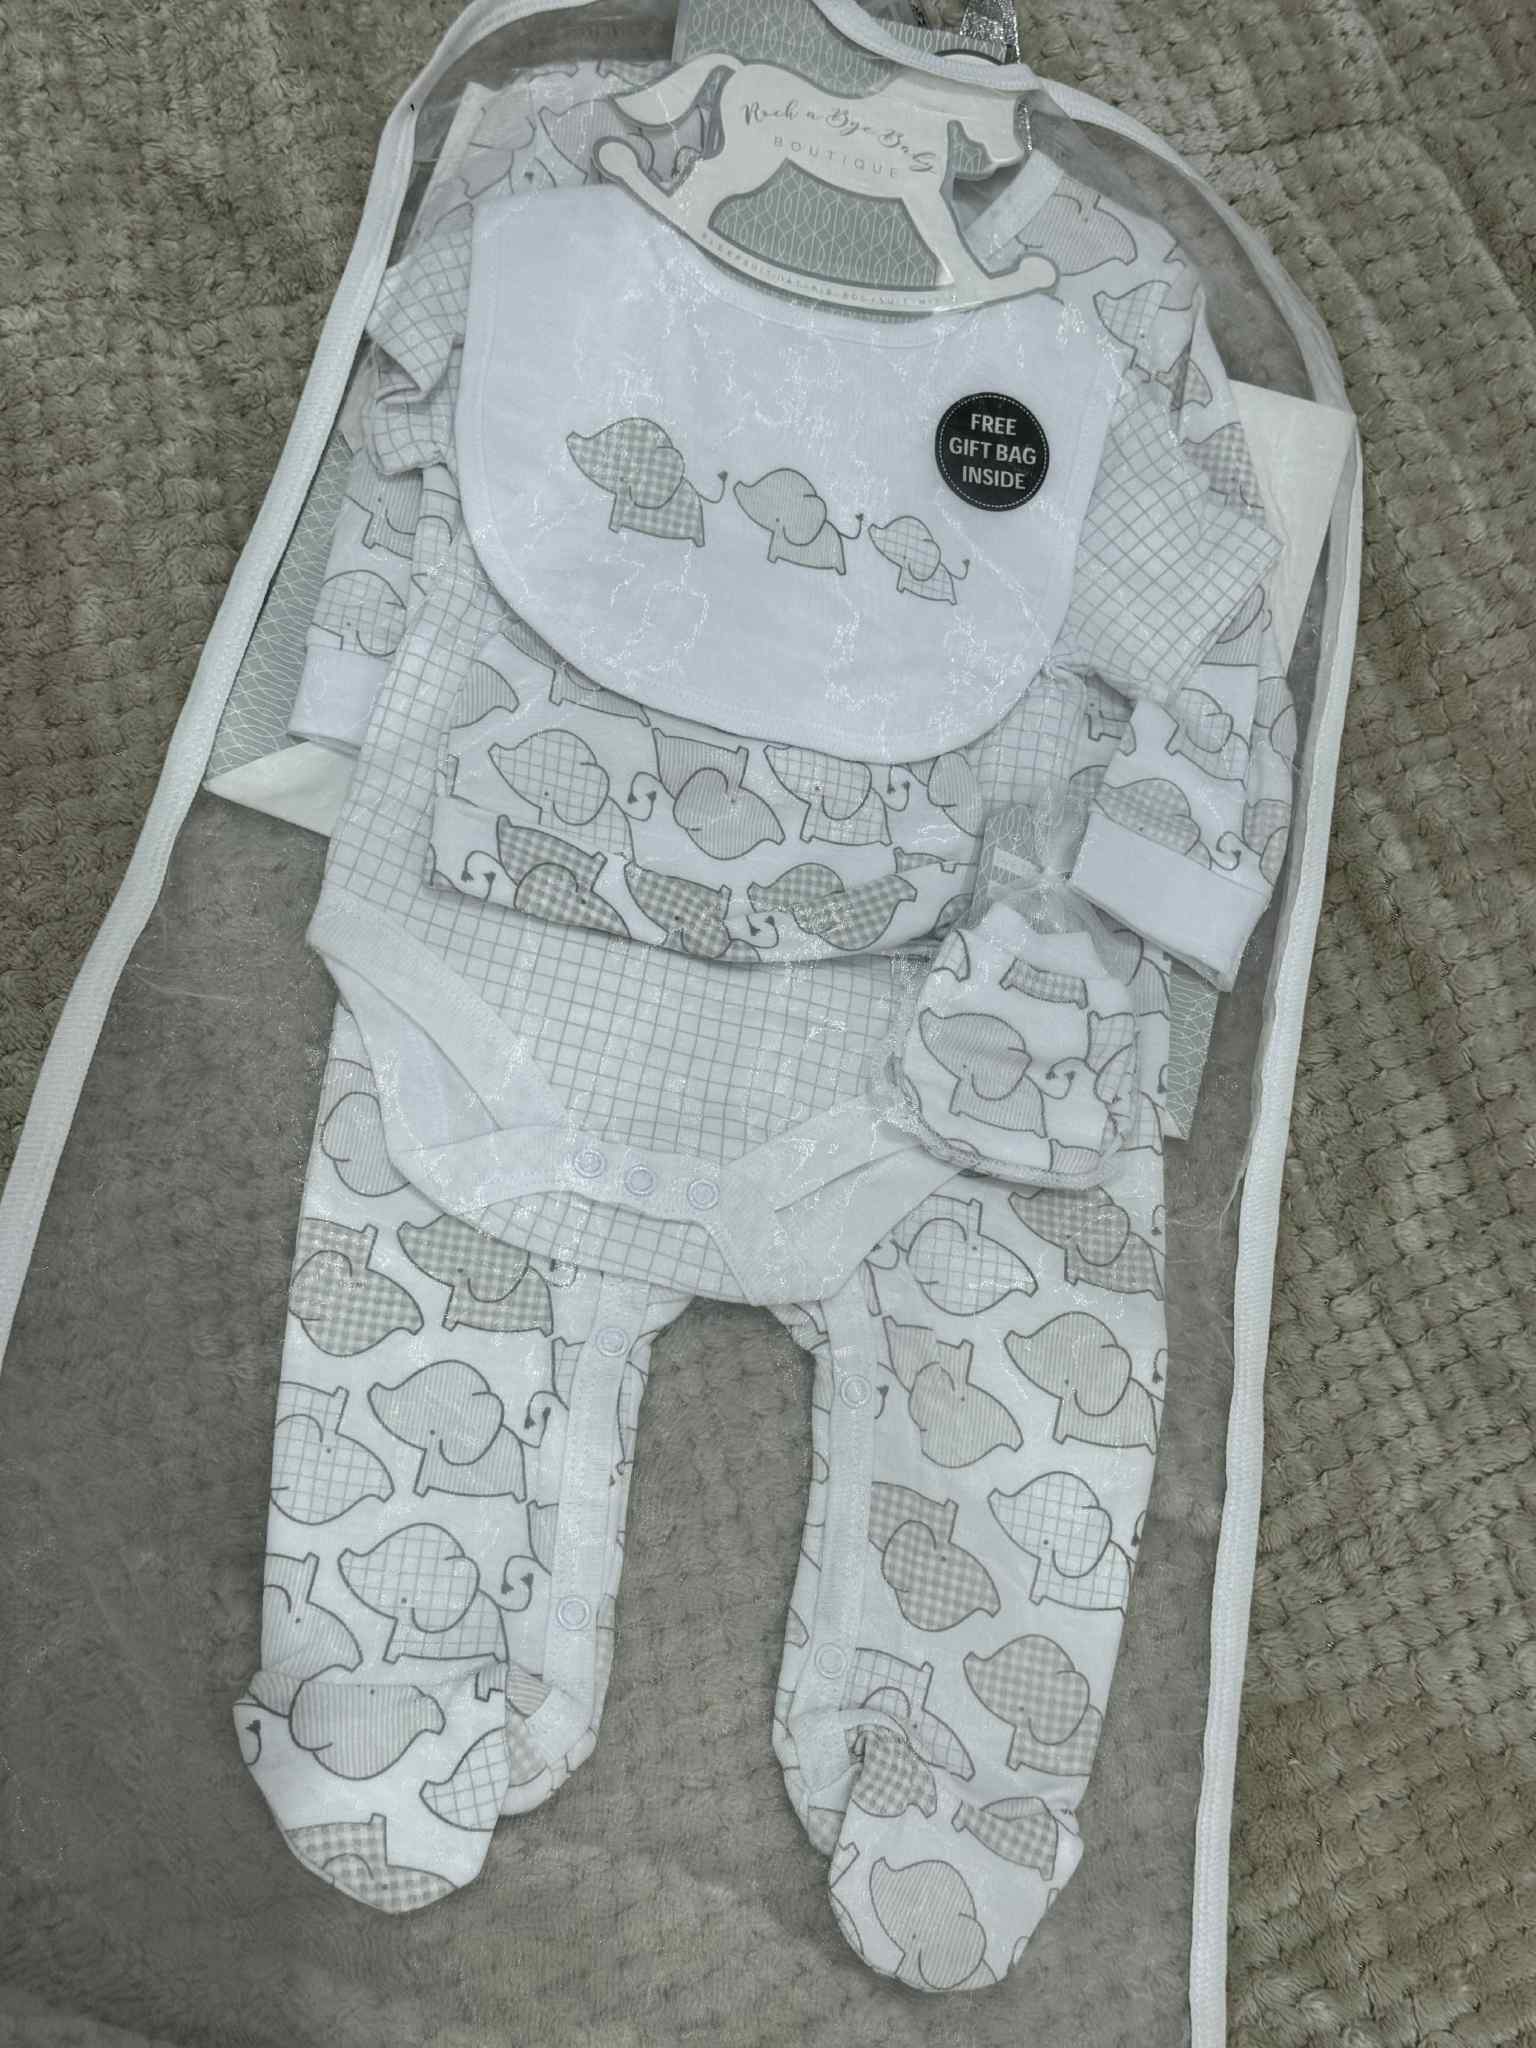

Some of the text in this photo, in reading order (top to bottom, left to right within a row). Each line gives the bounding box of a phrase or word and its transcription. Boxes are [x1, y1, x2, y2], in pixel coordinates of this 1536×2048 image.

[774, 135, 898, 179] BOUTIQUE
[970, 413, 1017, 436] FREE
[949, 437, 1037, 465] GIFT BAG
[962, 465, 1026, 490] INSIDE
